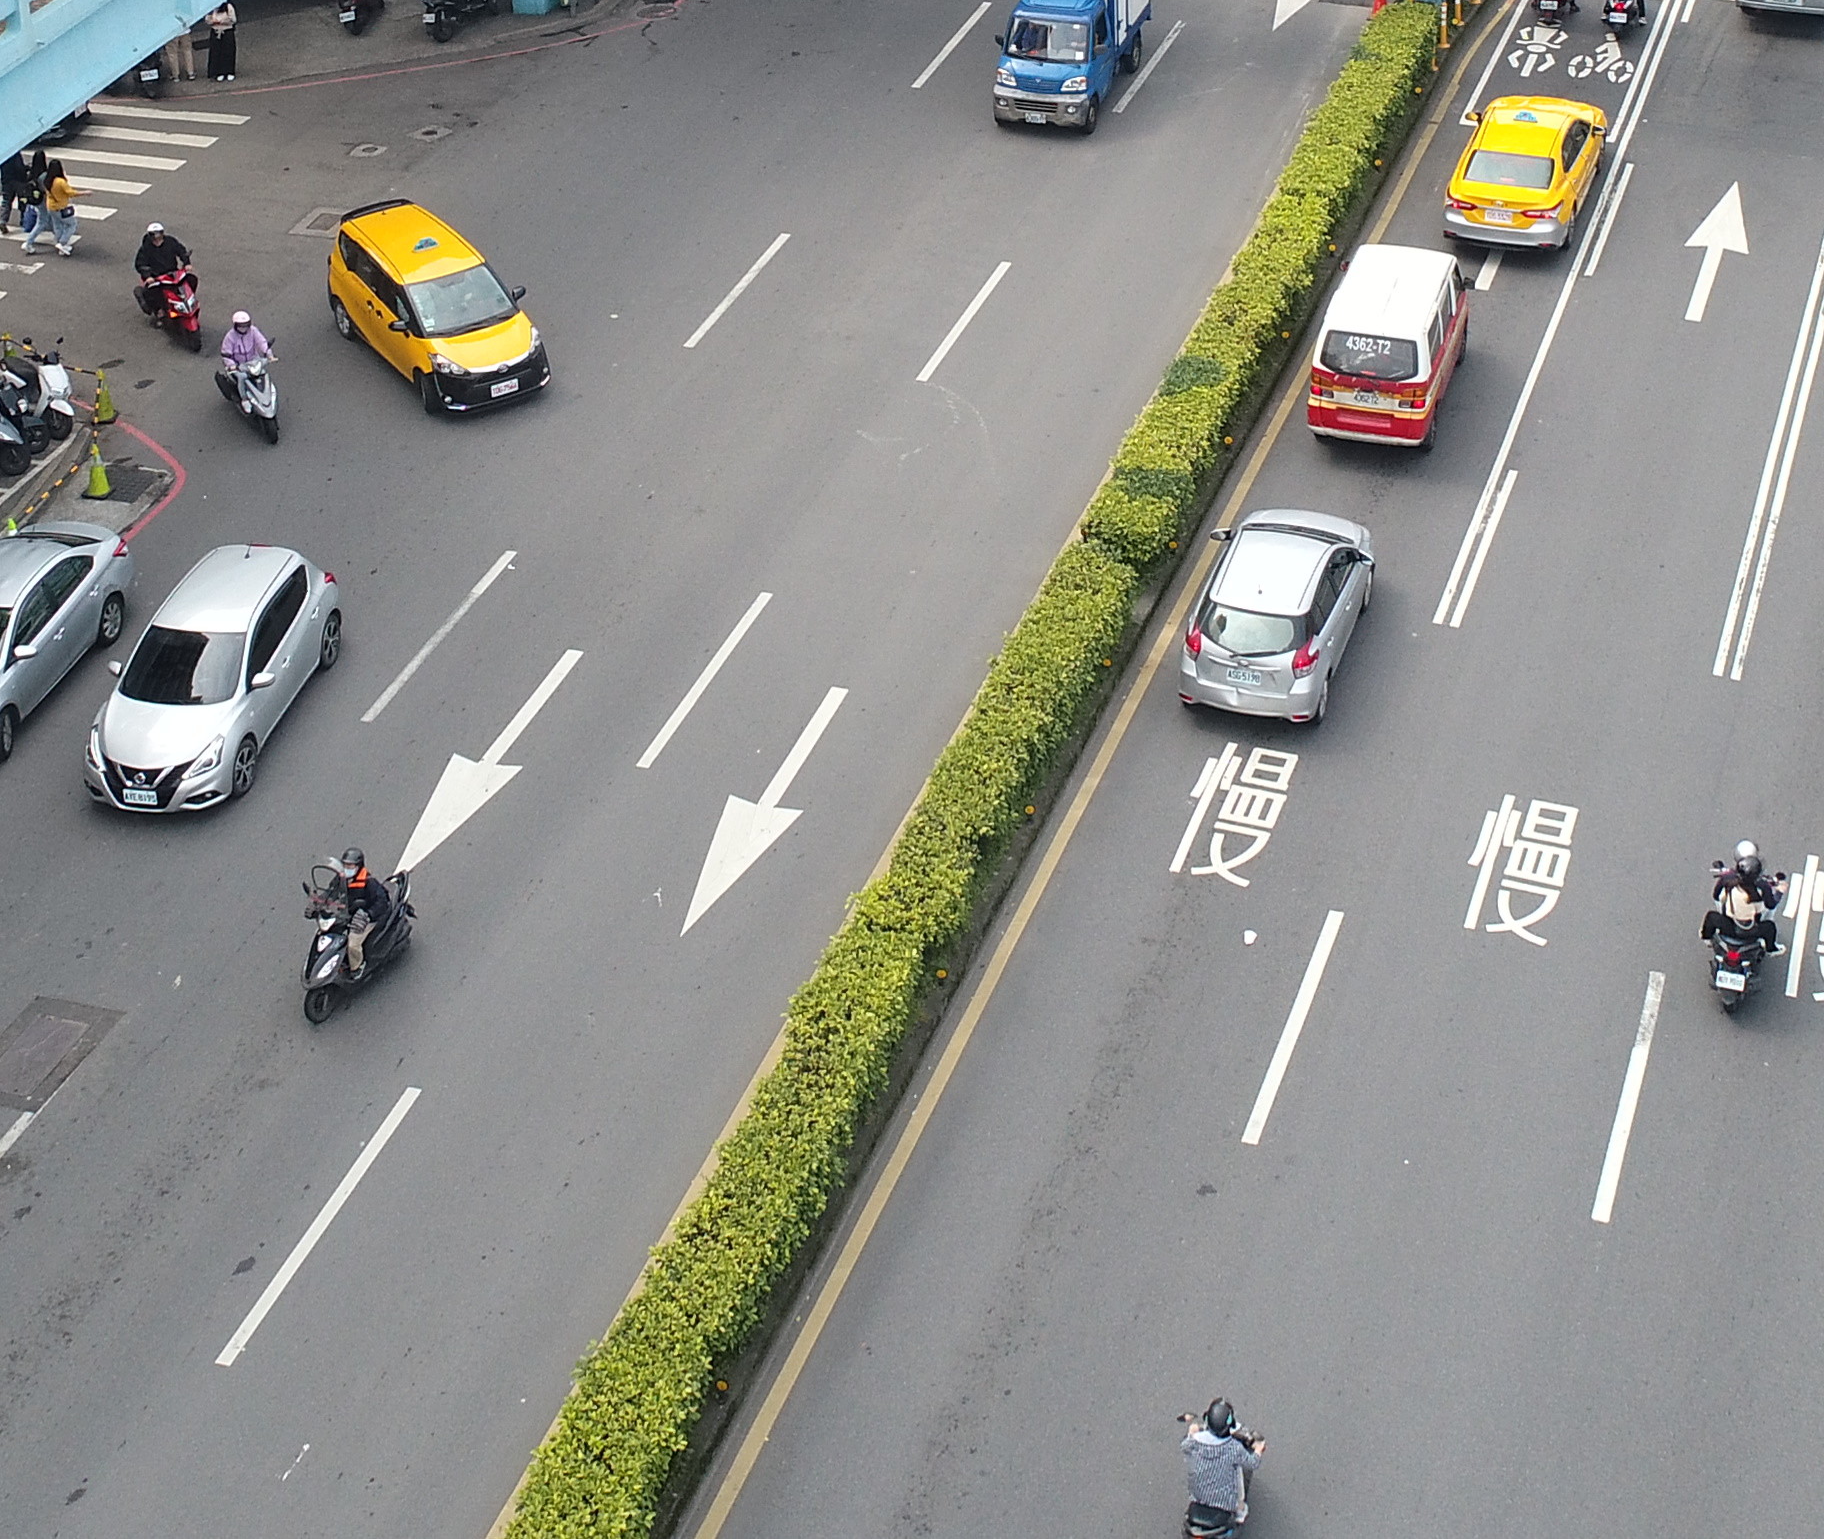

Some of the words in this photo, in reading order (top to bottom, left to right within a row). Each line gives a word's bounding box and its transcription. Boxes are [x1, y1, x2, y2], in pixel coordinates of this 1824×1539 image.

[1346, 336, 1391, 355] 4362-T2
[1170, 742, 1298, 887] 慢
[1463, 794, 1579, 946] 慢
